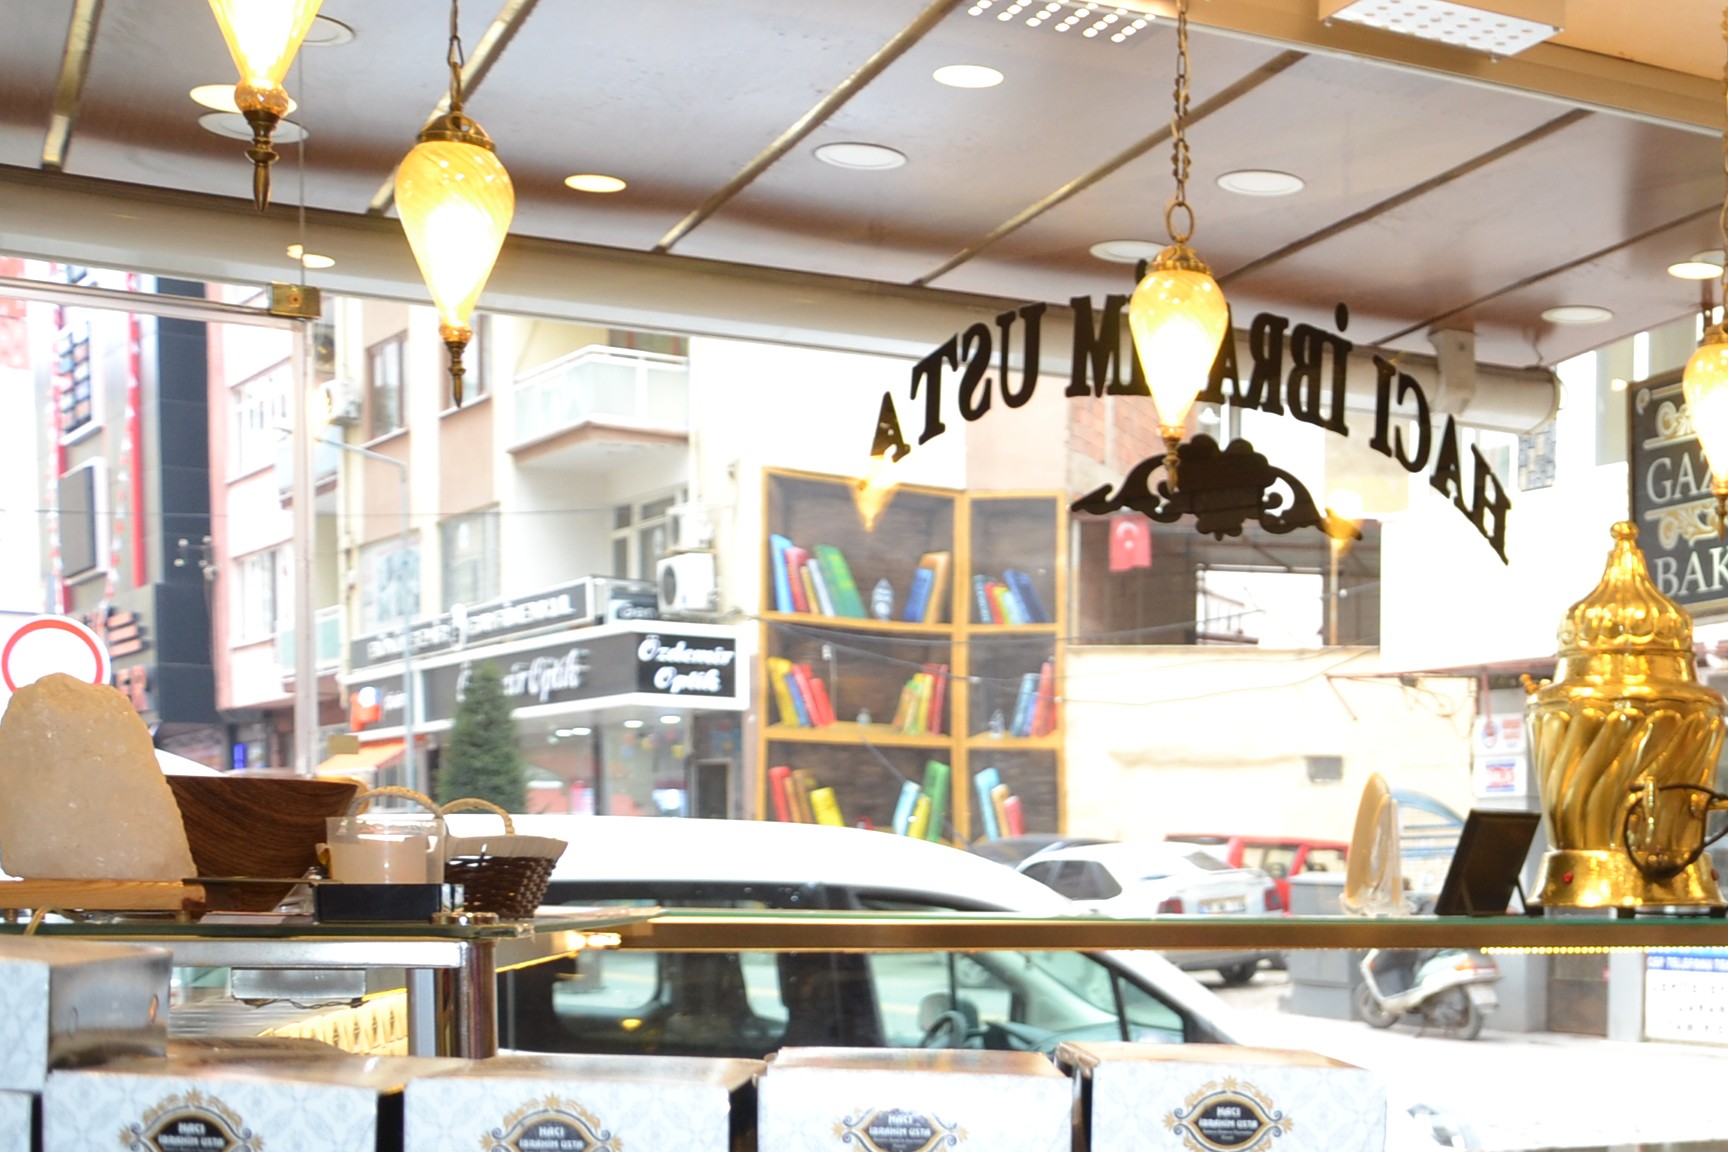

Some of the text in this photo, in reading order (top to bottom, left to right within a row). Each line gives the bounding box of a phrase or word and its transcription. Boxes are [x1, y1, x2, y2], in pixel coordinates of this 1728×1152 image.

[654, 666, 722, 694] Optik
[1217, 1108, 1240, 1117] HACI
[179, 1123, 205, 1134] HACI
[1237, 1120, 1257, 1128] USTA
[539, 1127, 564, 1137] HACI
[909, 1129, 931, 1137] USTA
[201, 1137, 224, 1147] USTA
[561, 1140, 584, 1149] USTA
